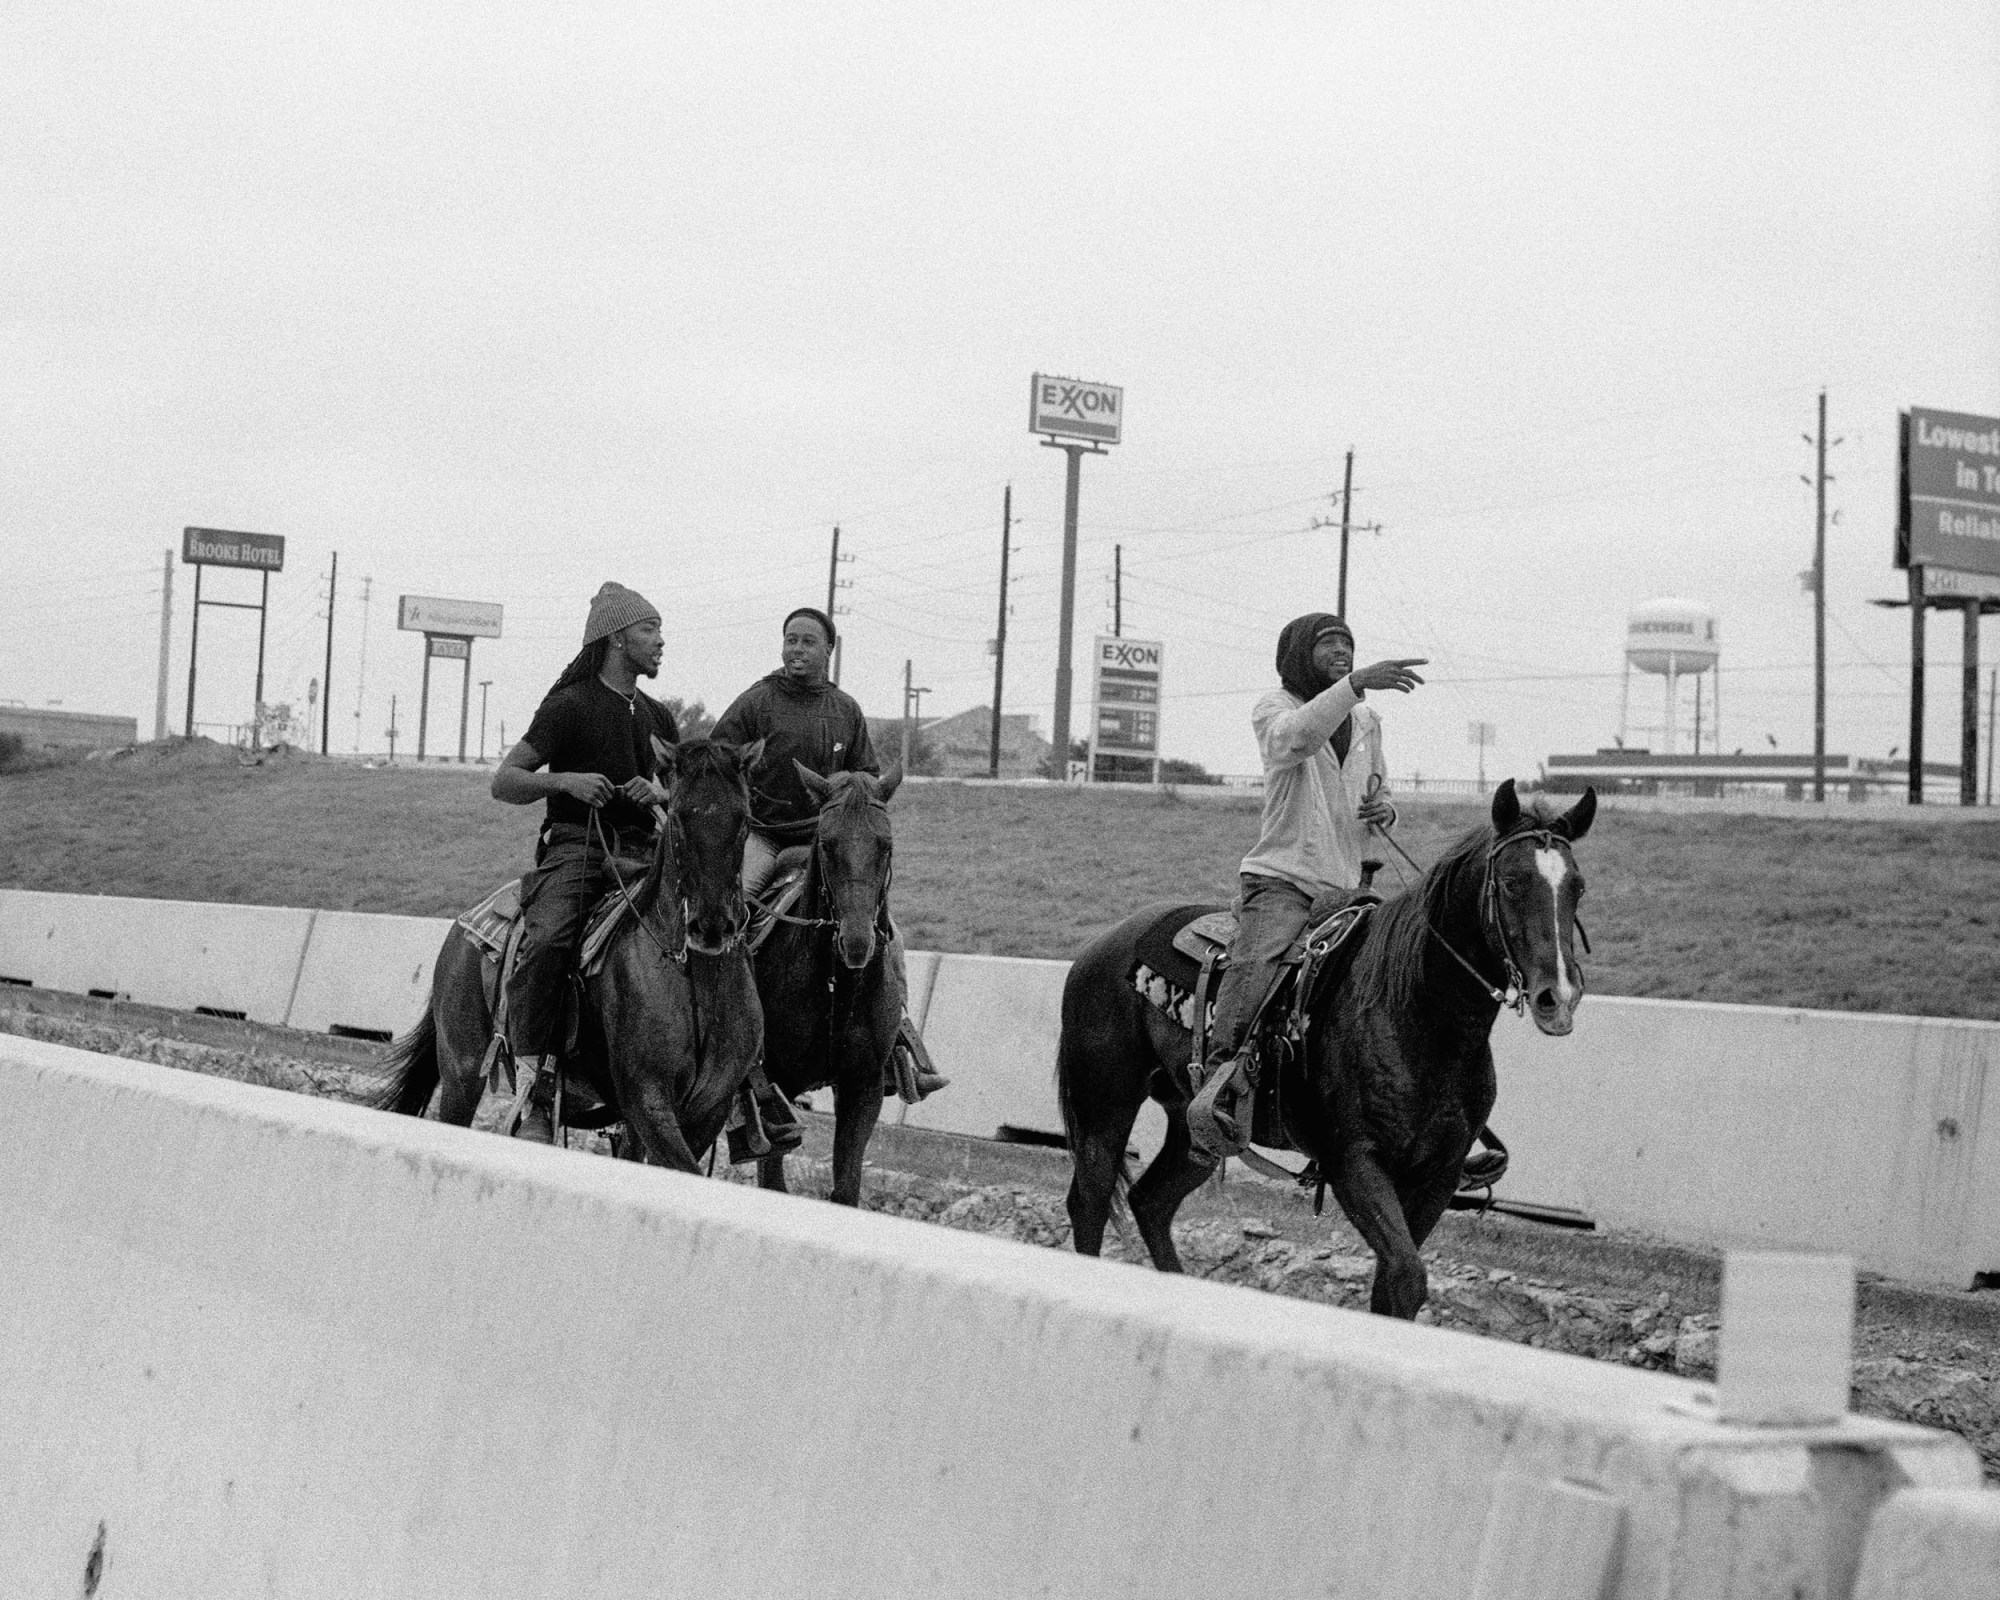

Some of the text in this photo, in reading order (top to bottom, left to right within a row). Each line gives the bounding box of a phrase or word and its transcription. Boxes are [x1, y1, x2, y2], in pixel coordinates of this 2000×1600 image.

[1042, 384, 1117, 420] EXXON
[1917, 416, 2000, 457] Lowest
[189, 538, 281, 566] BROOKE HOTEL
[1102, 643, 1159, 669] EXXON
